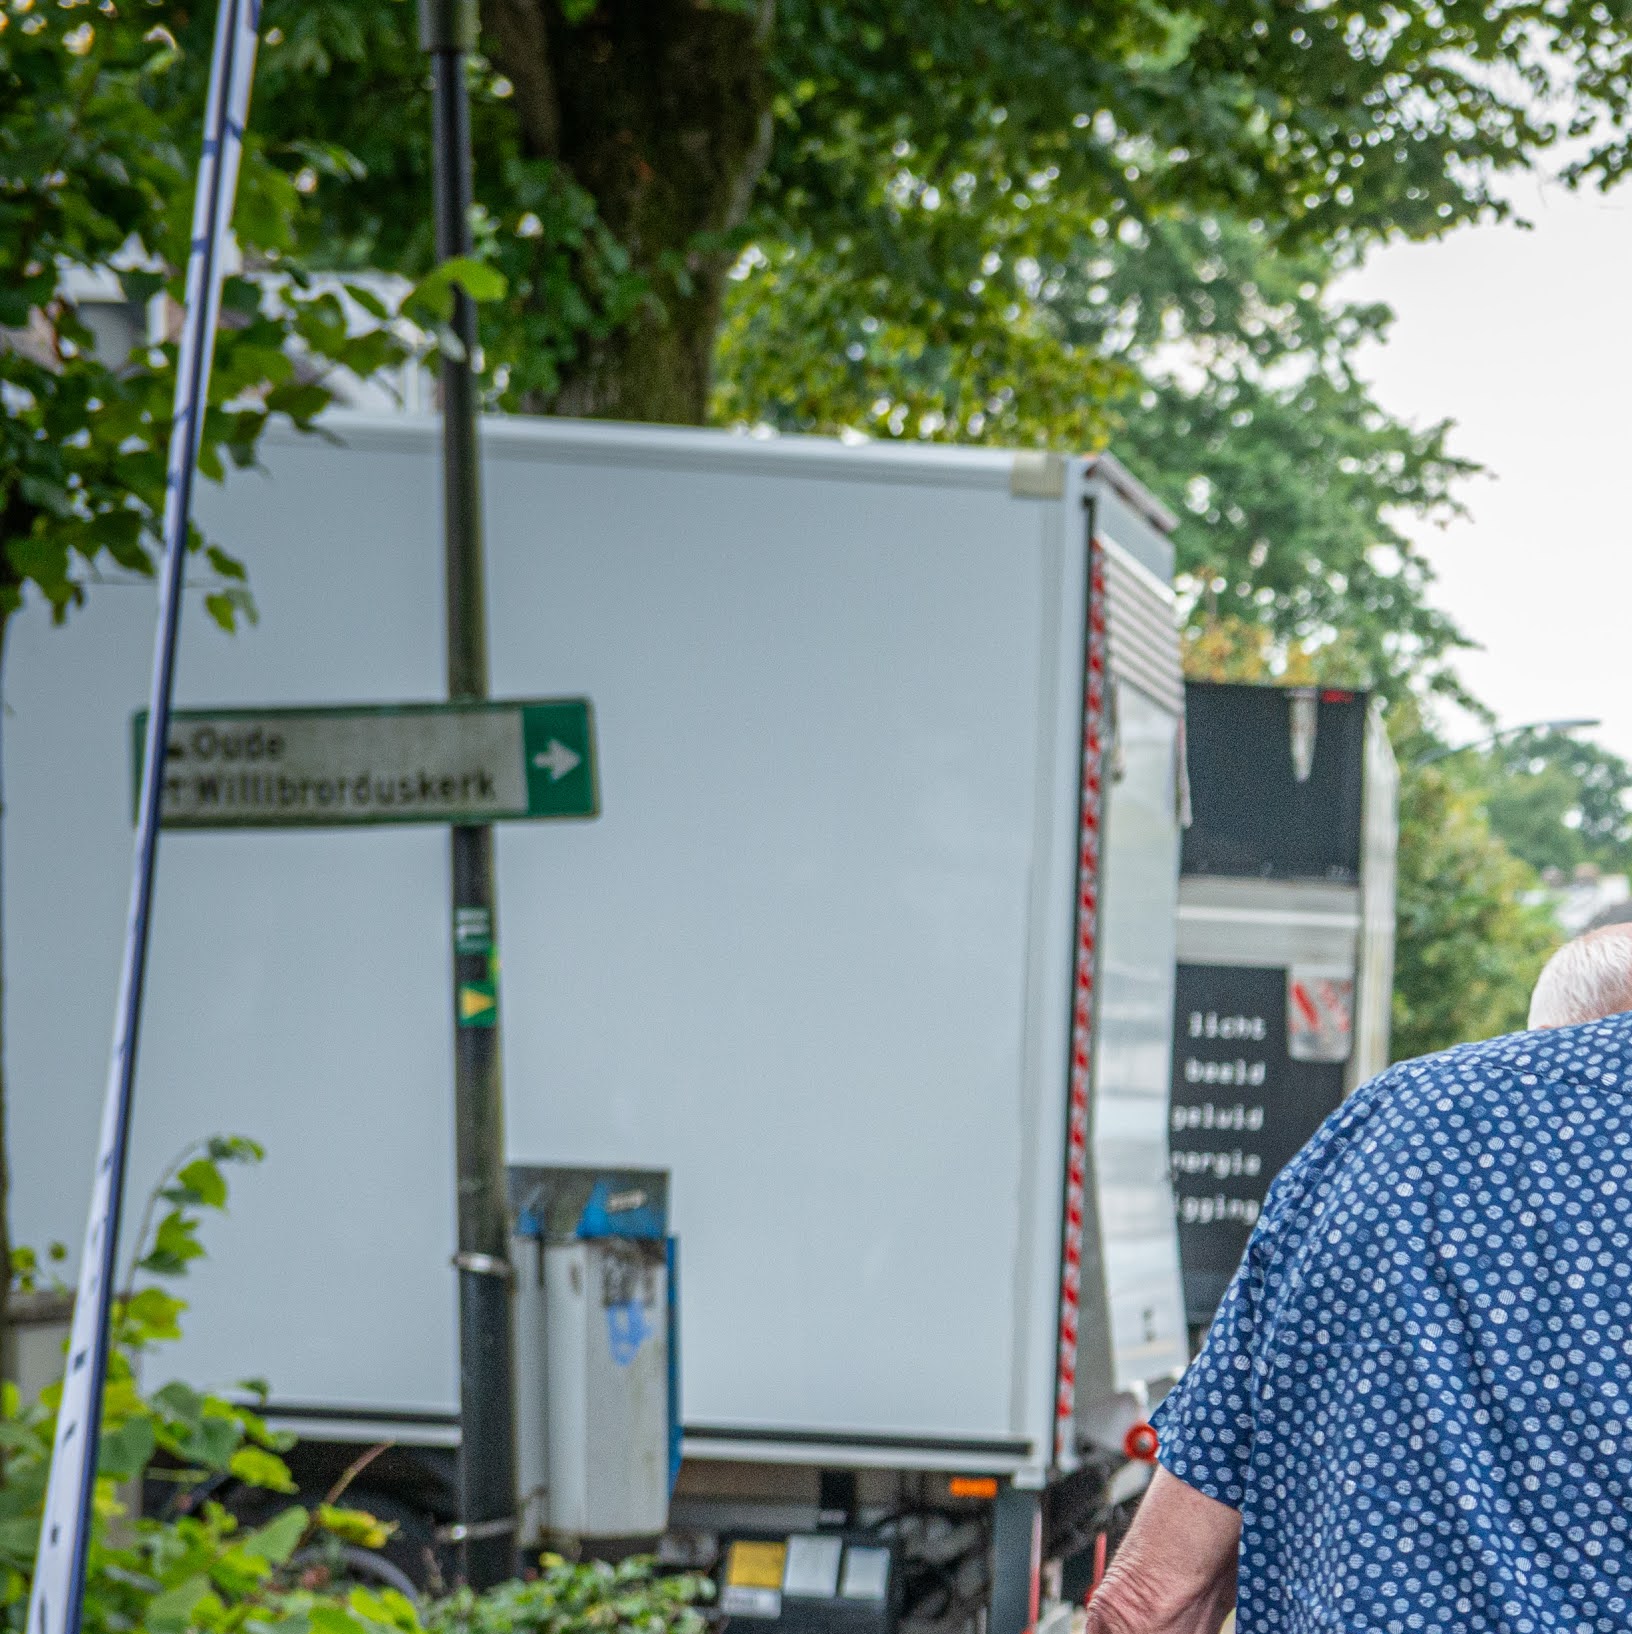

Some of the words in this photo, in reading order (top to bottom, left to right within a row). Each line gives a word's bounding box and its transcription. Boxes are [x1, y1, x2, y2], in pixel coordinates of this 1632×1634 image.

[191, 726, 286, 762] Oude
[198, 768, 496, 806] Willibrorduskerk
[1188, 1010, 1267, 1041] licht
[1184, 1056, 1267, 1086] beeld
[1171, 1102, 1264, 1132] geluid
[1171, 1149, 1262, 1180] nergie
[1172, 1191, 1260, 1226] igging
